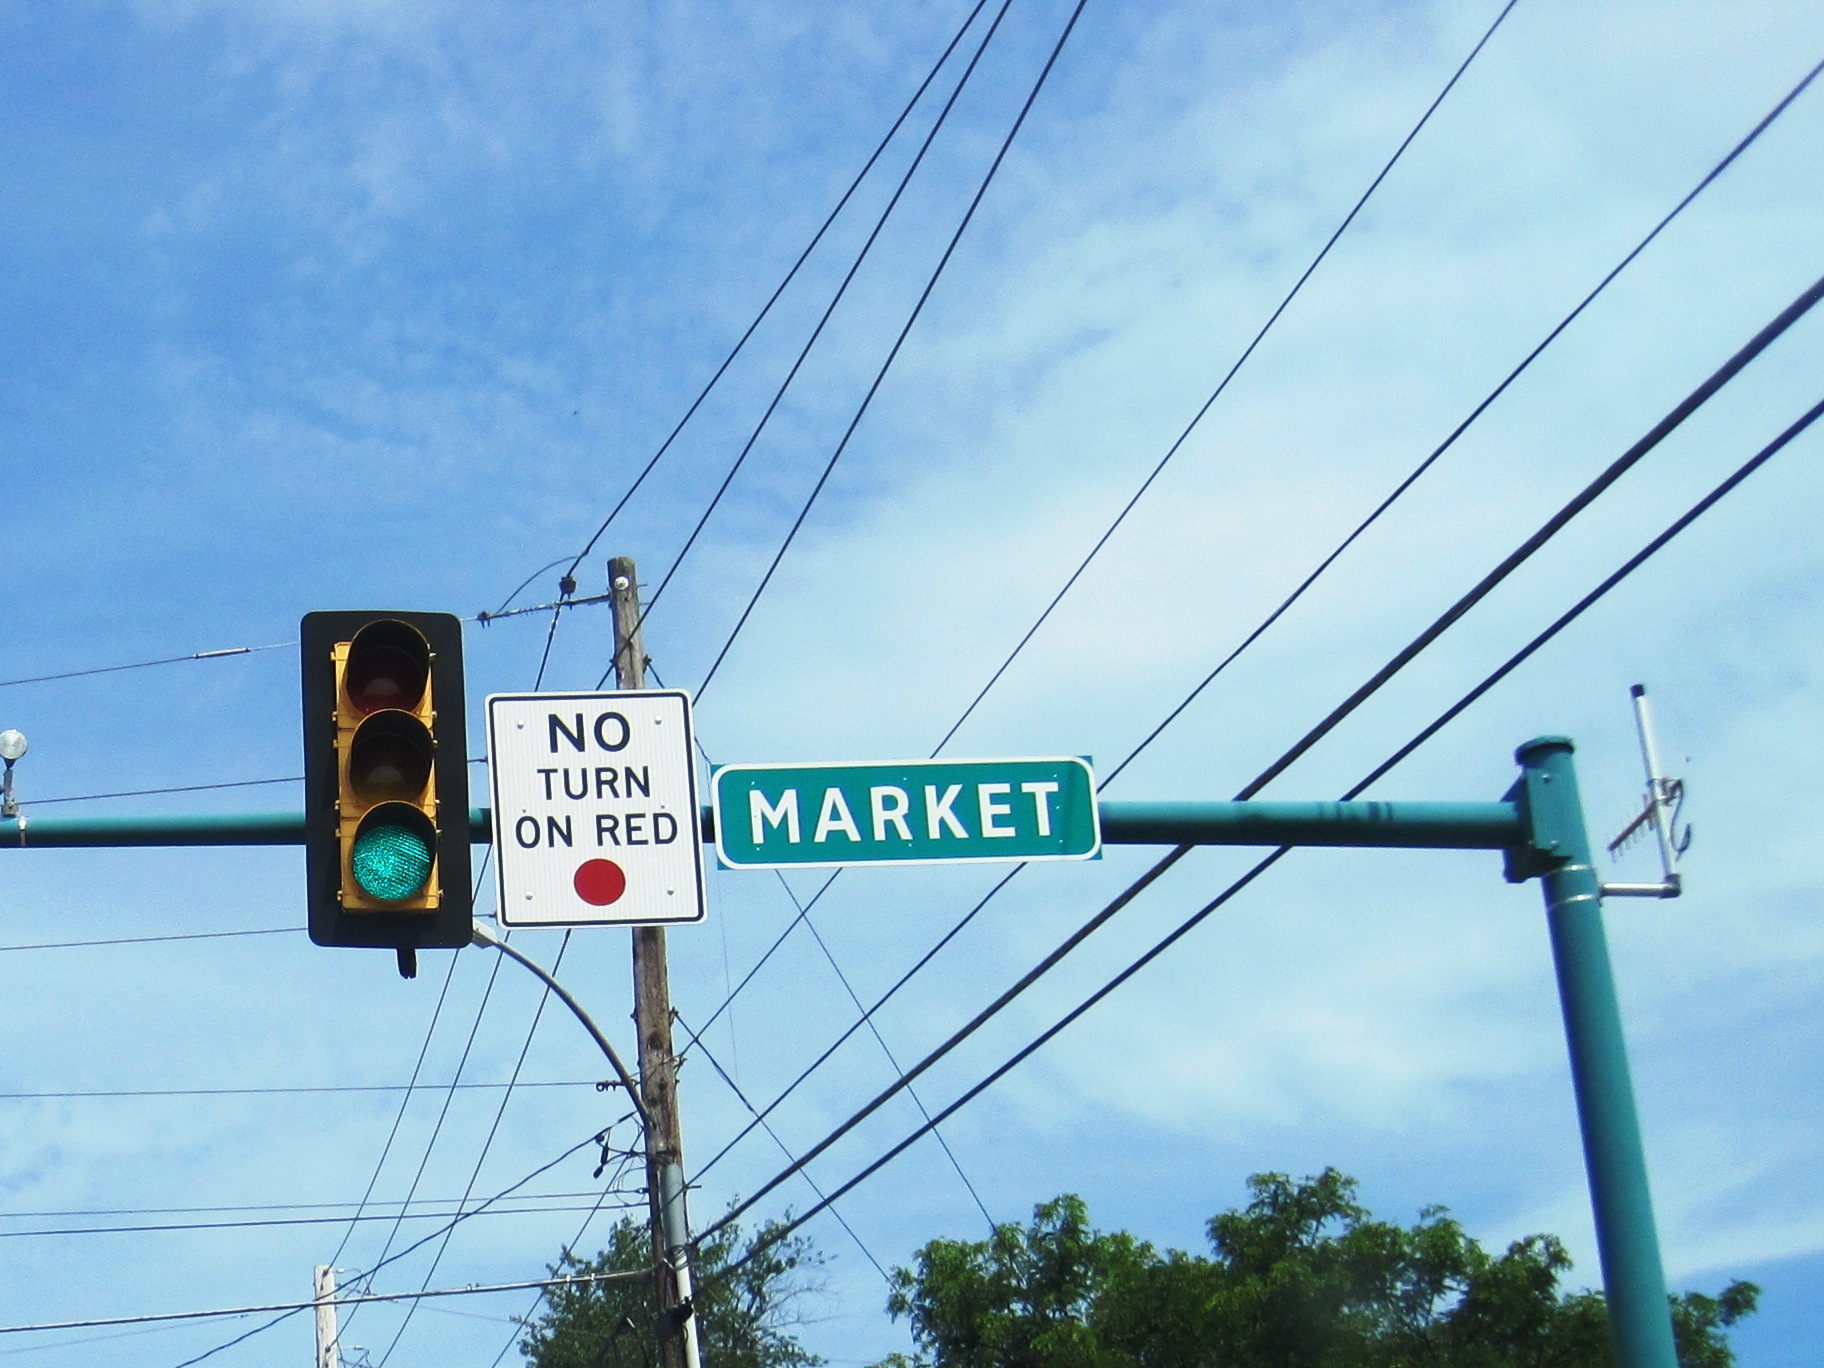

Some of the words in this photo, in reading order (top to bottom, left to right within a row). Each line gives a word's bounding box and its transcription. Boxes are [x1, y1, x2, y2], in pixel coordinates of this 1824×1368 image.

[547, 711, 631, 753] NO
[537, 766, 650, 801] TURN
[515, 814, 573, 849] ON
[596, 812, 678, 847] RED
[748, 781, 1060, 845] MARKET
